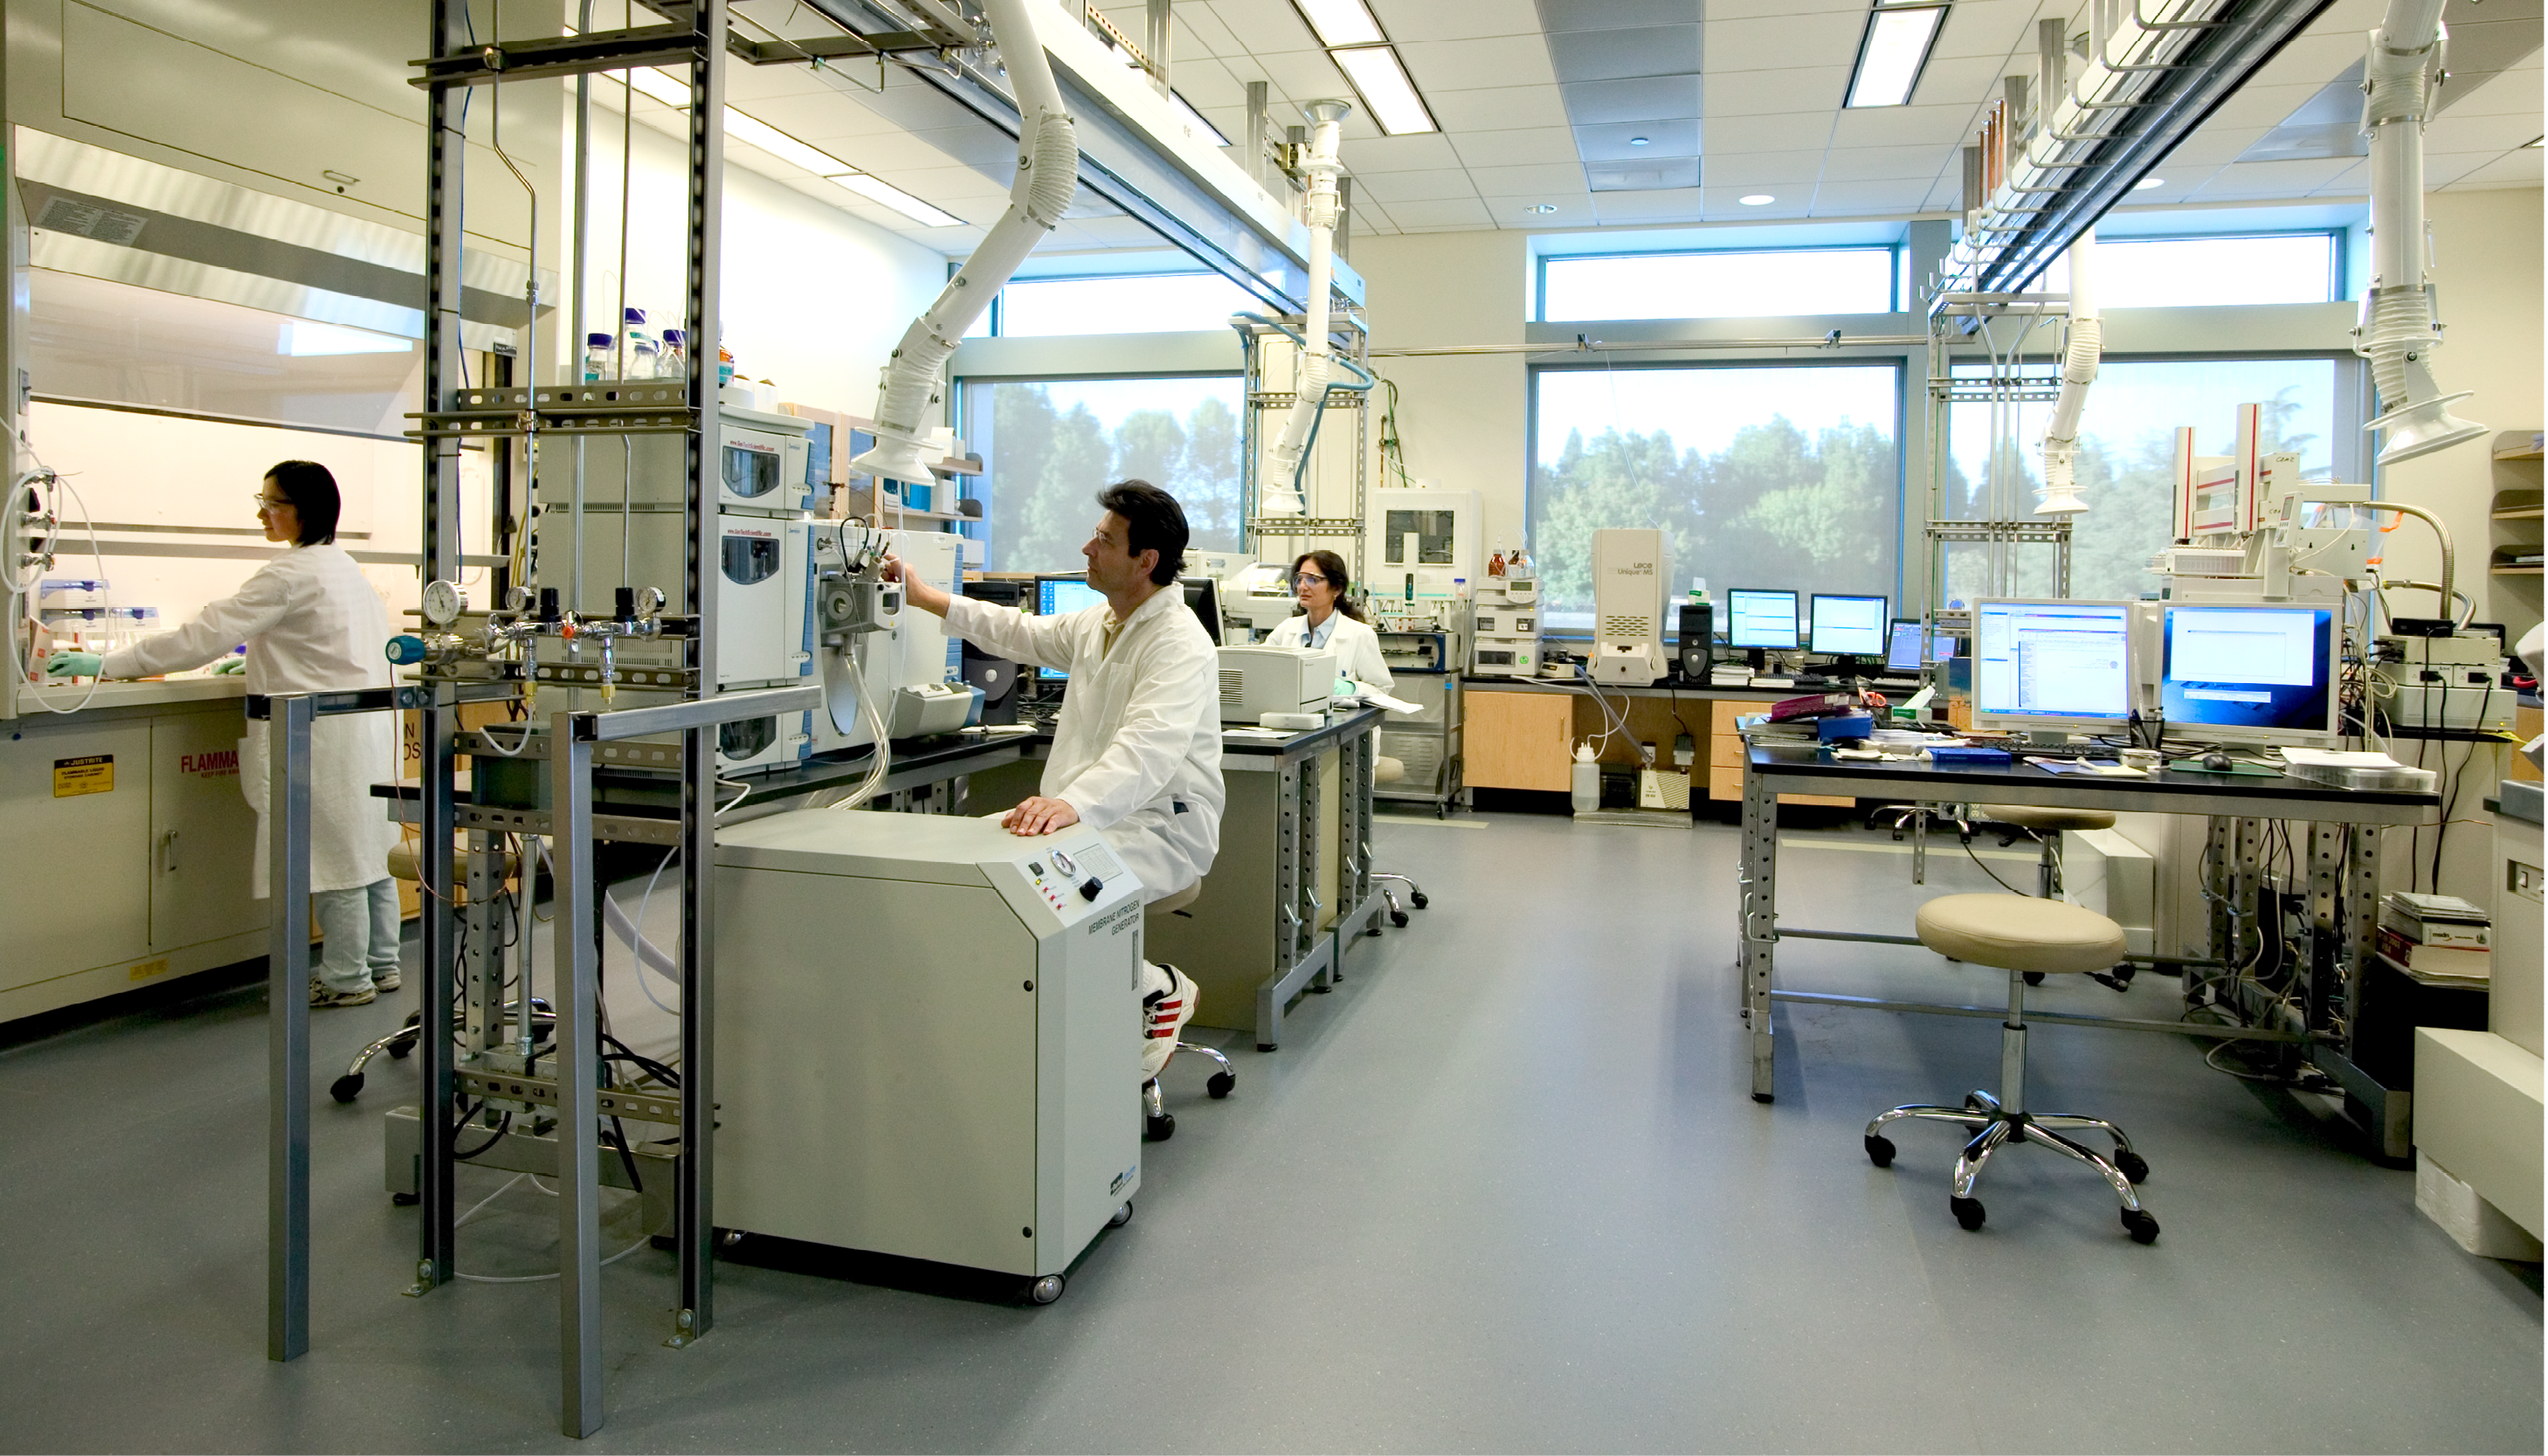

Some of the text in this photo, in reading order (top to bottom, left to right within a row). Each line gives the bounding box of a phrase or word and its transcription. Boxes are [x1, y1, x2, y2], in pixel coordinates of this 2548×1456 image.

[71, 756, 103, 766] JUSTRITE
[181, 750, 239, 774] FLAMMA
[1088, 899, 1139, 935] MEMBRANE NITROGEN
[1111, 913, 1139, 935] GENERATOR
